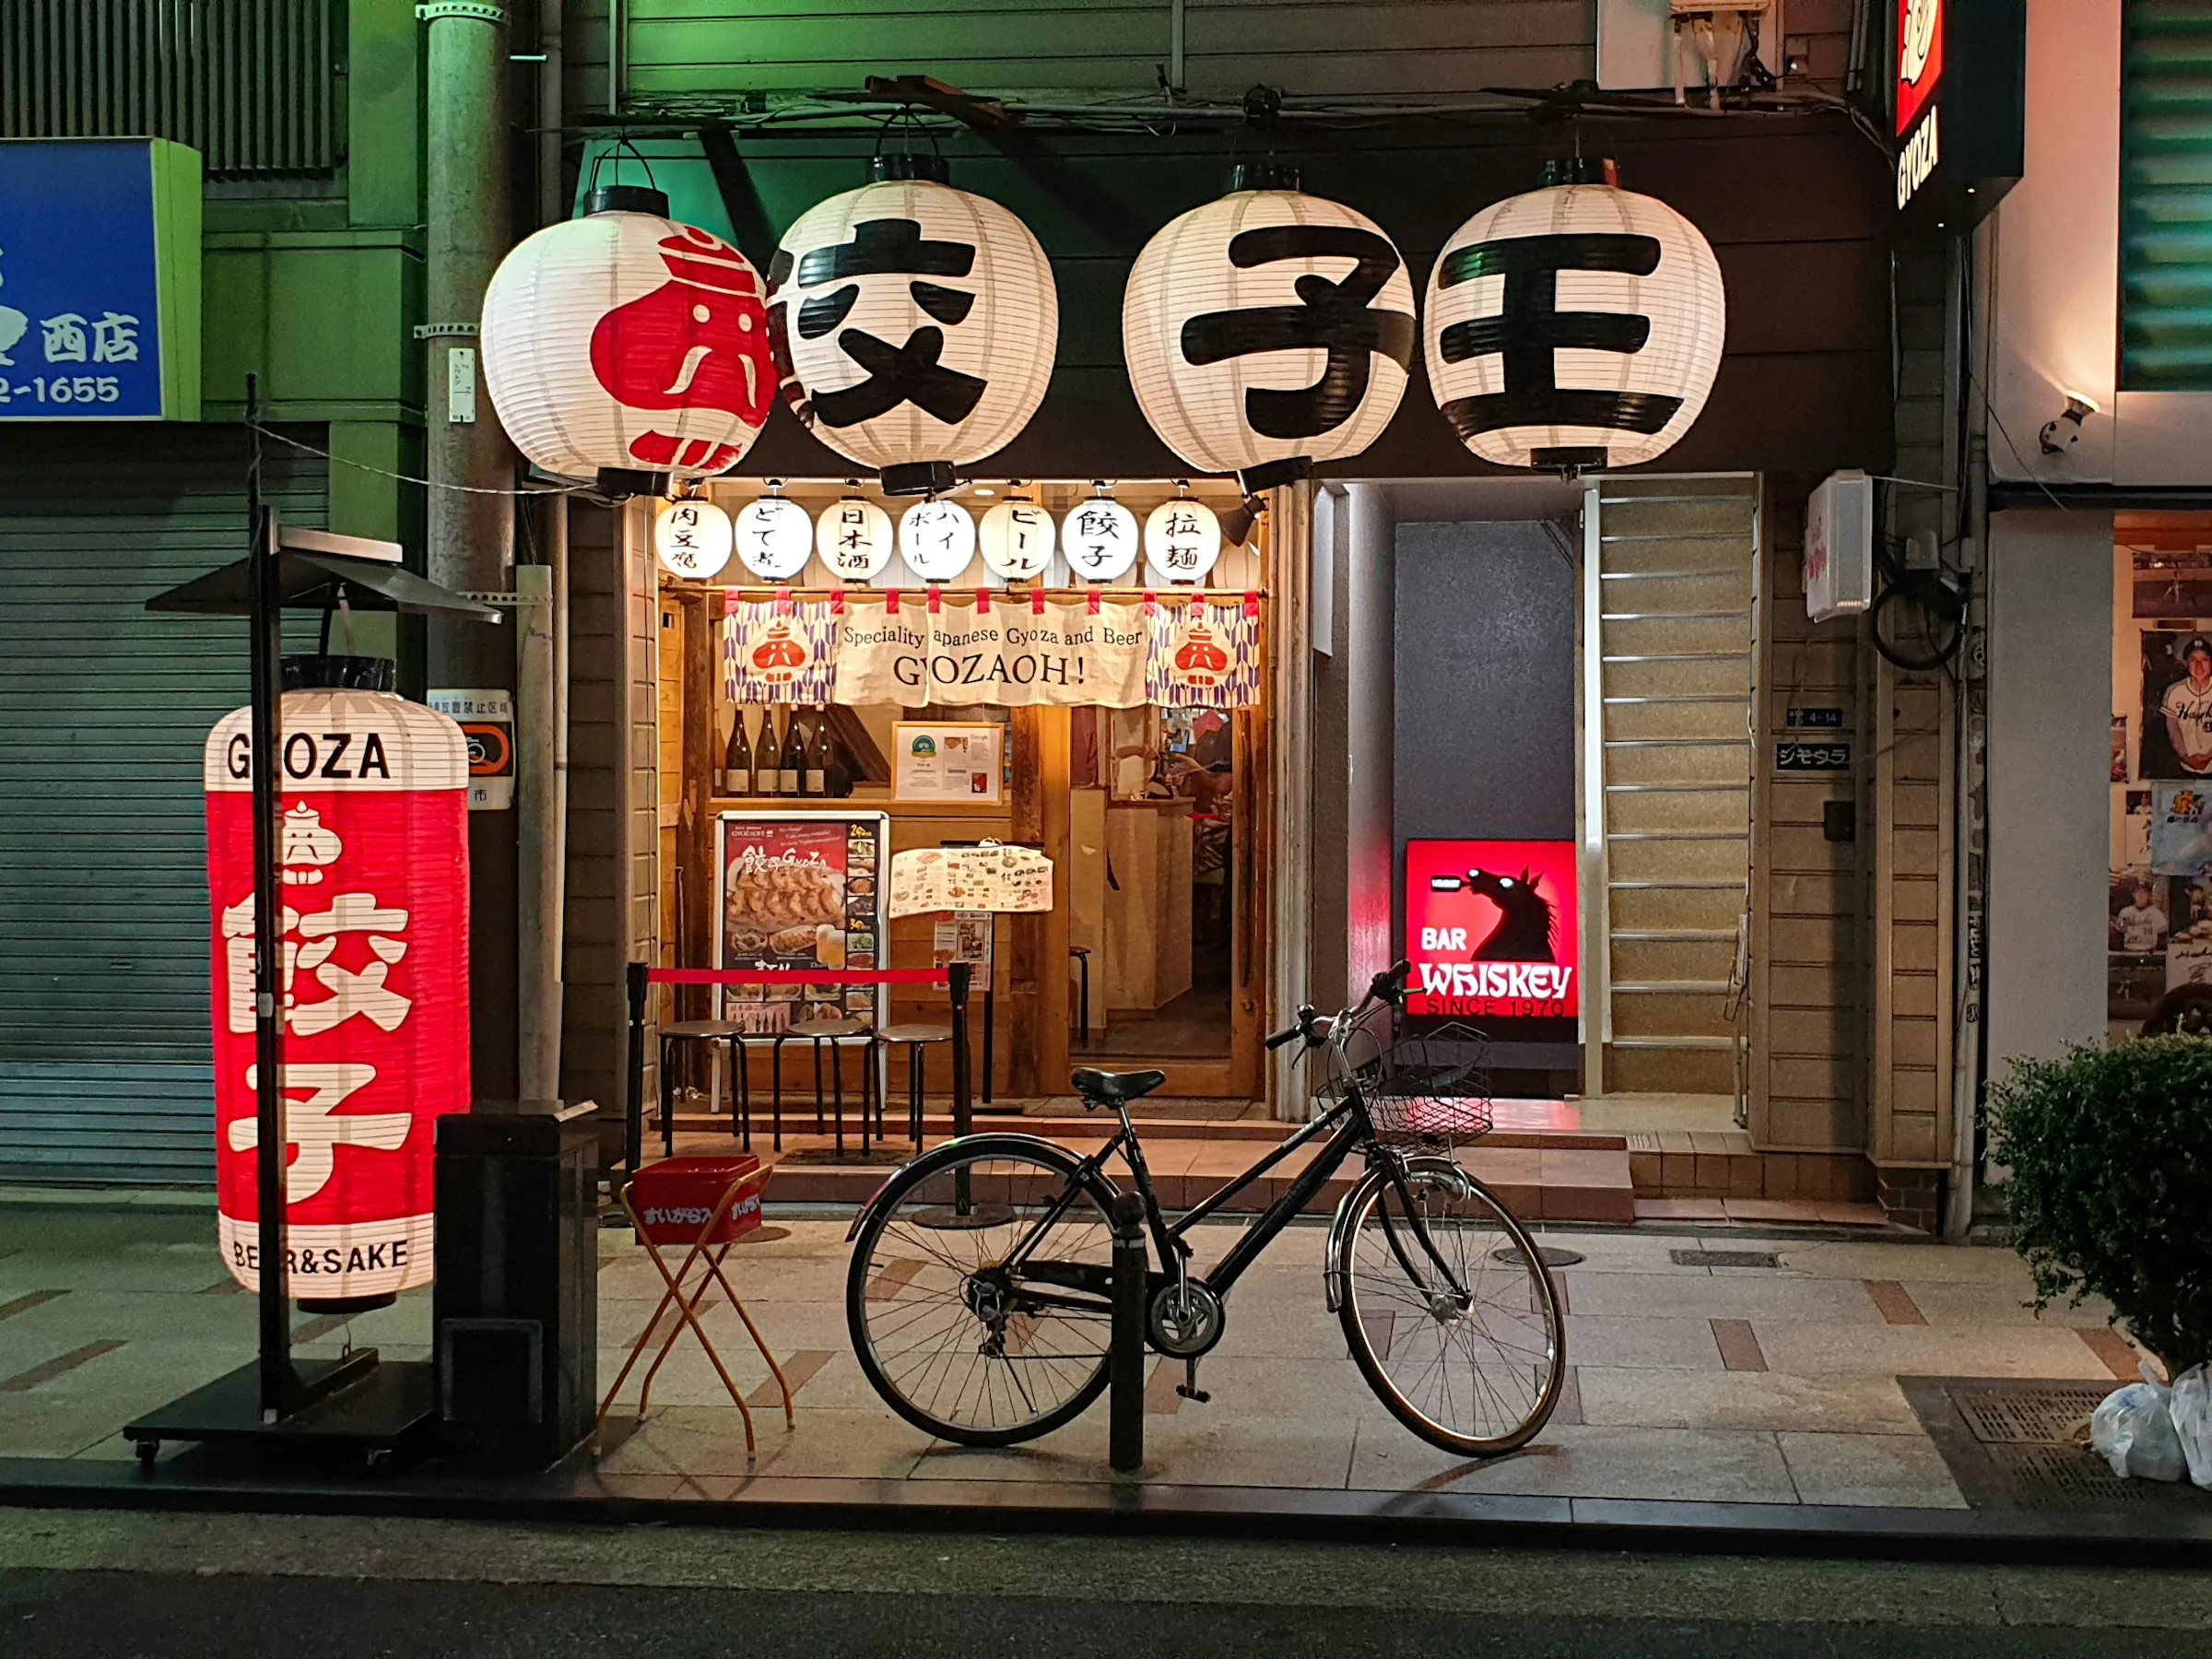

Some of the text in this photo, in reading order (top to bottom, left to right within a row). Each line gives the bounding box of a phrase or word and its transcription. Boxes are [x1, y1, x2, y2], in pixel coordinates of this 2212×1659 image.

[1897, 104, 1938, 210] GYOZA
[837, 509, 873, 569] 日本酒
[1000, 509, 1040, 571] ビール
[1077, 511, 1119, 567] 餃子
[844, 626, 1143, 649] Speciality apanese Gyoza and Beer
[227, 733, 392, 780] GOZA
[1420, 927, 1467, 950] BAR
[1426, 998, 1565, 1016] SINCE 1970
[233, 1241, 408, 1275] BER&SAKE
